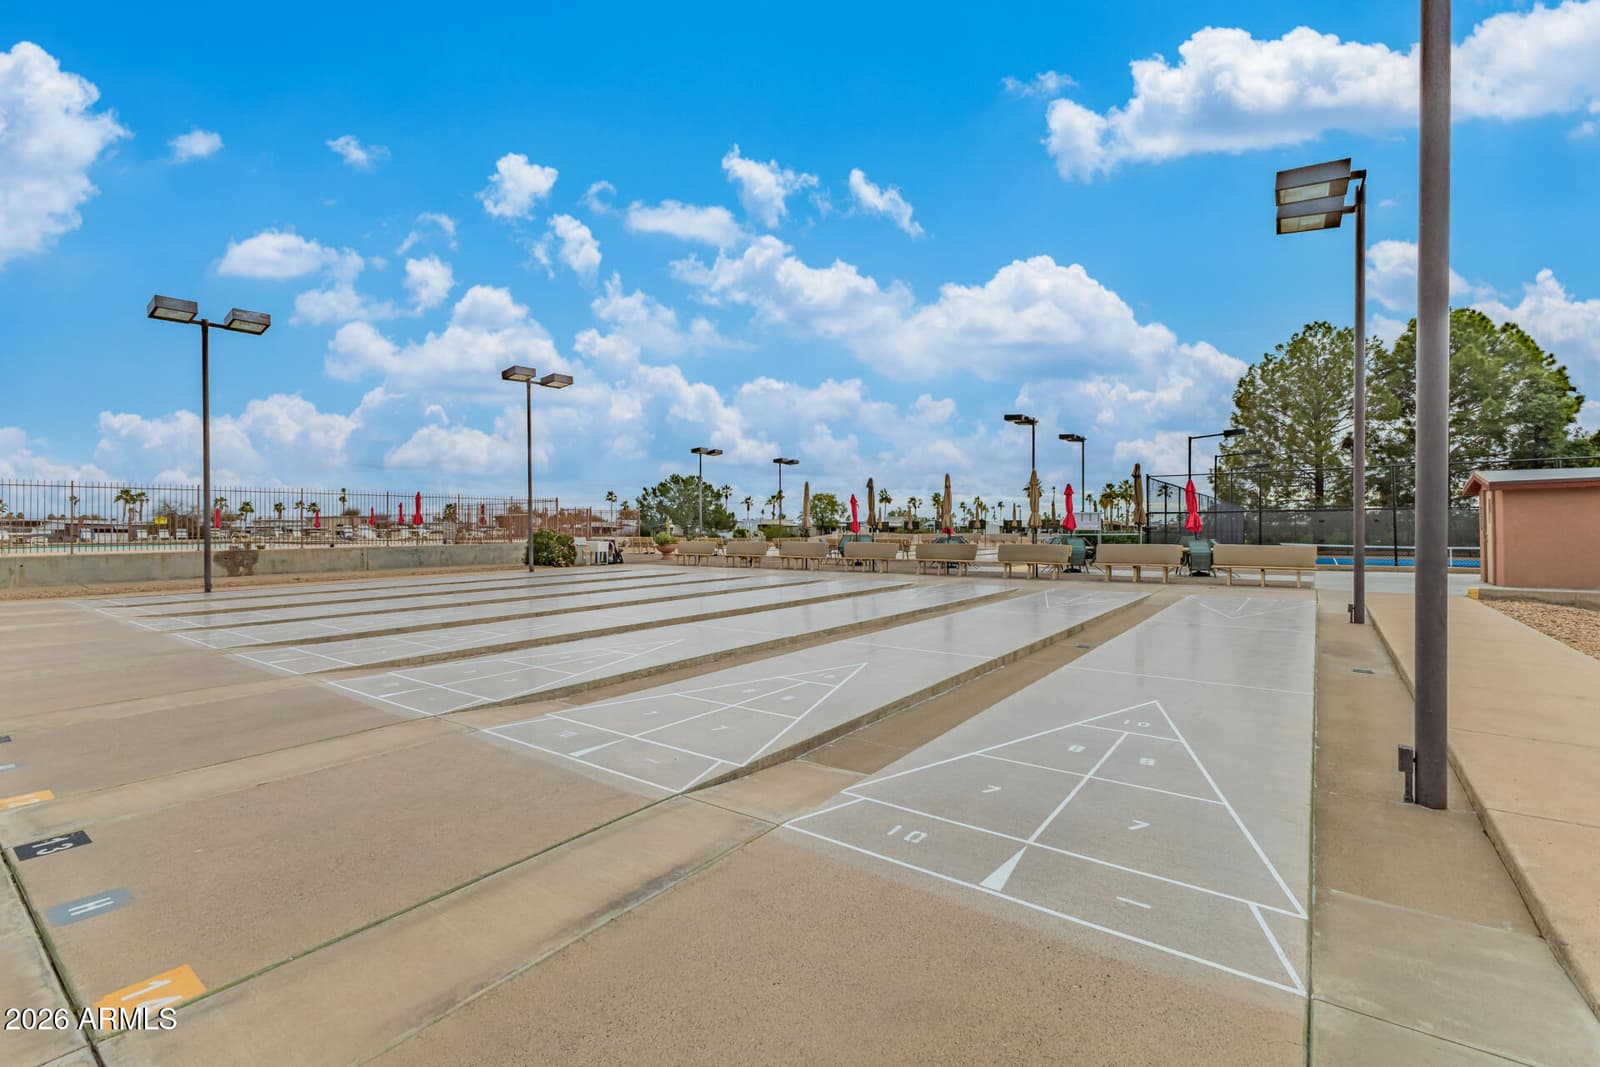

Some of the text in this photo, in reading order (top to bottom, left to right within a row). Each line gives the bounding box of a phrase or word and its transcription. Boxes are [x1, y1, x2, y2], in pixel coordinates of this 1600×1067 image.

[1127, 819, 1150, 830] 7
[887, 825, 928, 843] 10
[31, 836, 75, 856] 13
[68, 897, 114, 916] H
